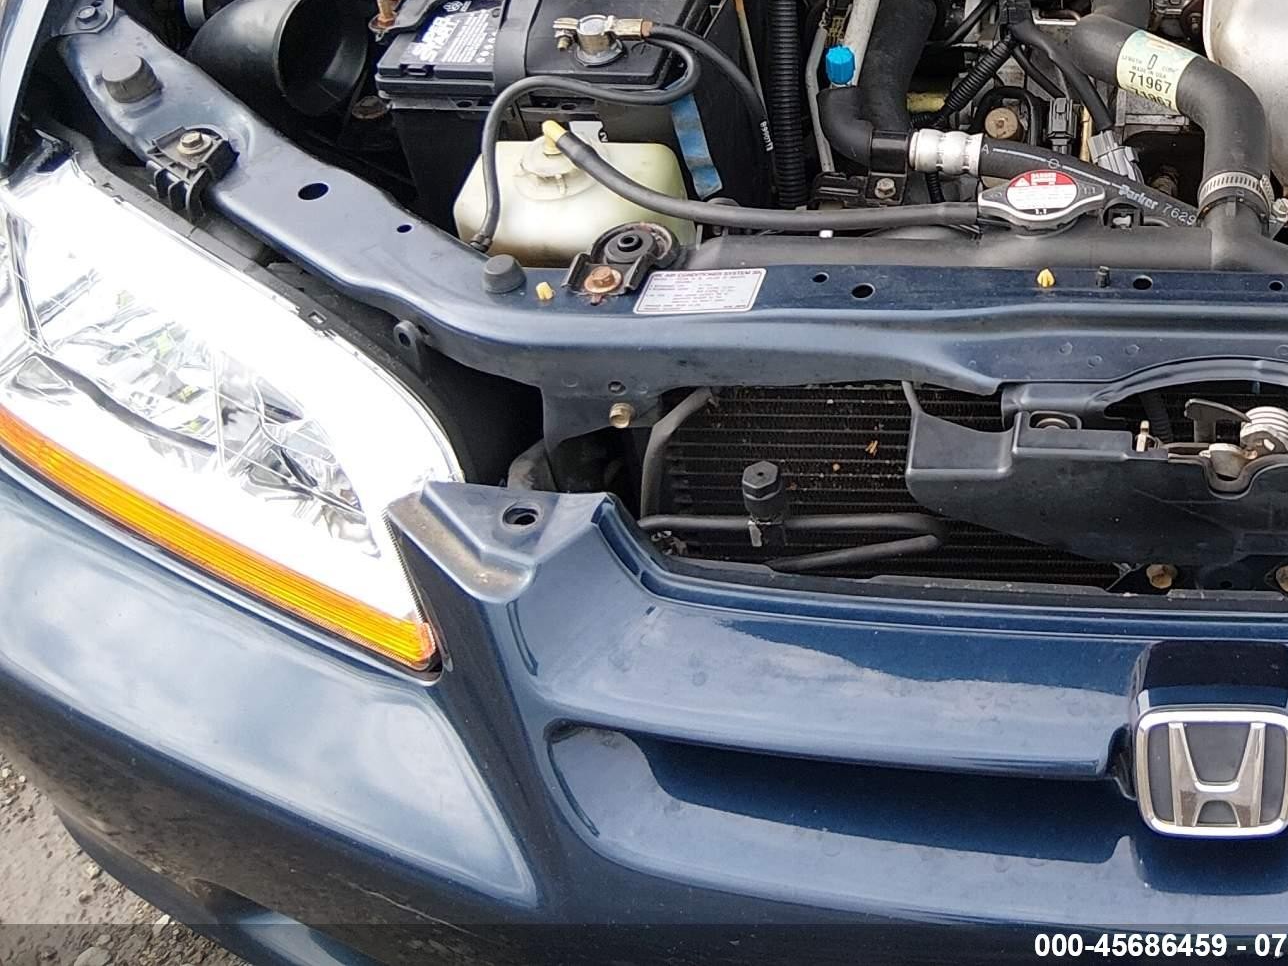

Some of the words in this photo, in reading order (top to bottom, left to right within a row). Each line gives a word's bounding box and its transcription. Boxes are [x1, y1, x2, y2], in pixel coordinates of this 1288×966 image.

[1129, 70, 1172, 94] 71967
[1118, 184, 1159, 209] Parker
[1163, 203, 1197, 225] 7629
